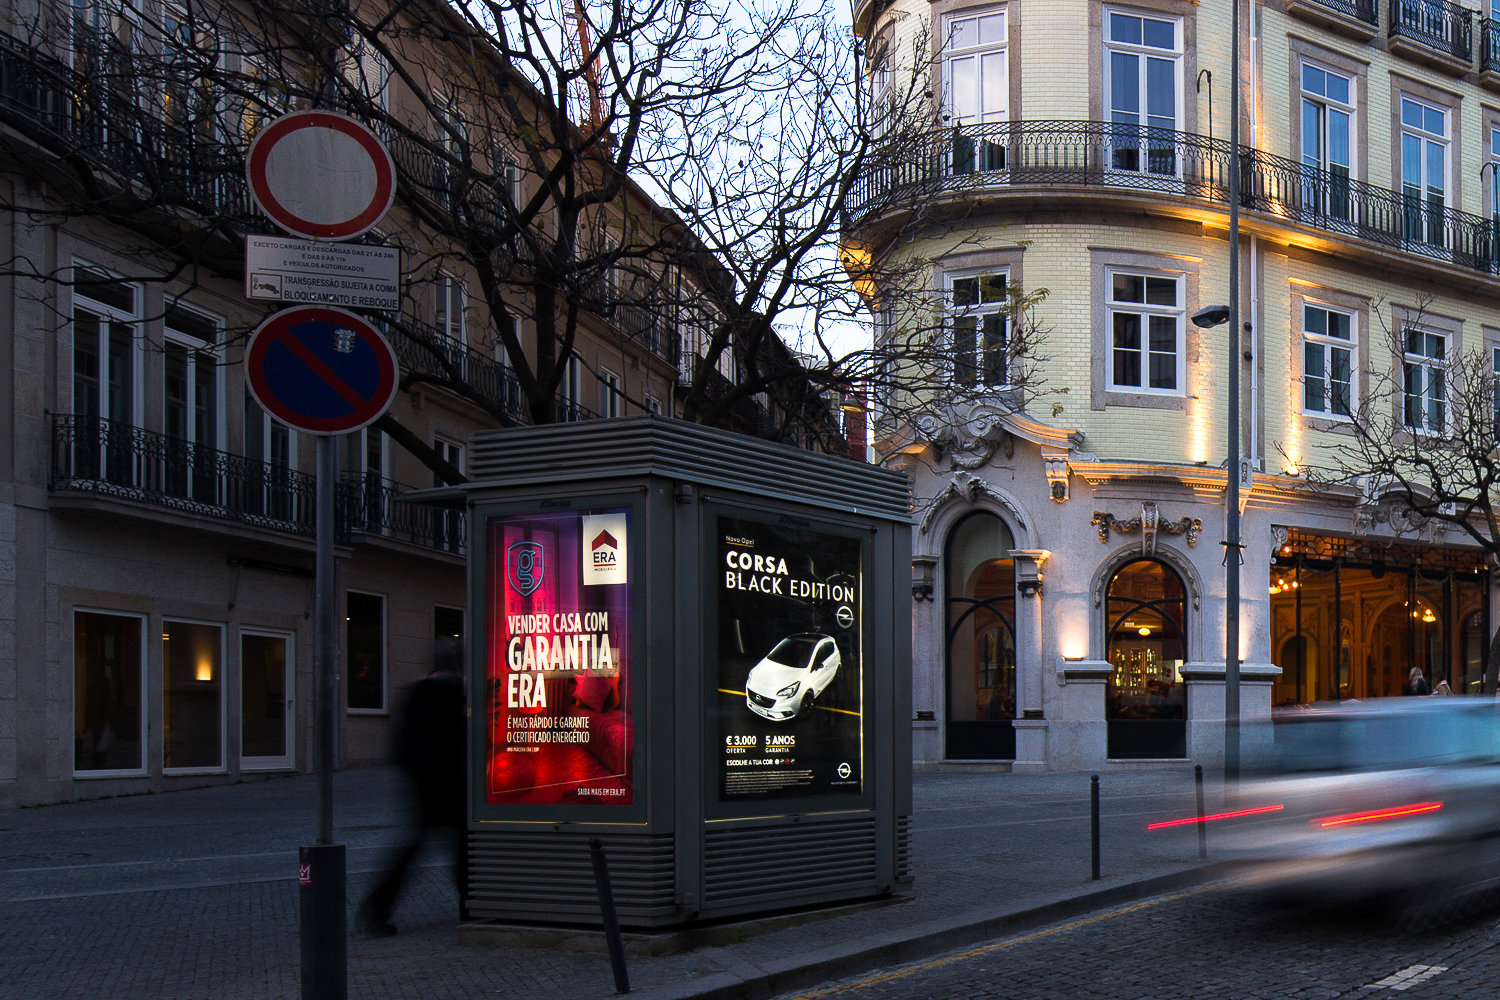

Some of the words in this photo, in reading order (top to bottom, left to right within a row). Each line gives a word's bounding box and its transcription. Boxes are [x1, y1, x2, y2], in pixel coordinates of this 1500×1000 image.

[279, 243, 305, 251] CARGAS
[312, 246, 350, 255] DESCARGAS
[320, 263, 365, 272] AUTORIZADOS
[284, 276, 339, 288] TRANSGRESSÃO
[340, 280, 368, 291] SUJEITA
[369, 283, 374, 291] A
[376, 283, 397, 293] COIMA
[352, 296, 357, 304] E
[359, 296, 397, 308] REBOQUE
[741, 537, 755, 545] Opel
[593, 552, 616, 563] ERA
[726, 550, 789, 576] CORSA
[726, 571, 783, 595] BLACK
[790, 579, 854, 603] EDITION
[508, 613, 550, 635] VENDER
[553, 612, 582, 633] CASA
[584, 611, 608, 632] COM
[508, 633, 613, 672] GARANTIA
[507, 673, 547, 709] ERA
[507, 714, 512, 729] É
[512, 717, 528, 729] MAIS
[529, 714, 553, 729] RÁPIDO
[554, 717, 558, 728] E
[559, 716, 590, 728] GARANTE
[507, 731, 512, 743] O
[513, 731, 551, 743] CERTIFICADO
[552, 729, 590, 743] ENERGÉTICO
[726, 736, 732, 745] €
[734, 735, 757, 746] 3.000
[765, 736, 771, 745] 5
[772, 735, 796, 745] ANOS
[577, 788, 590, 796] SAIBA
[591, 788, 602, 796] MAIS
